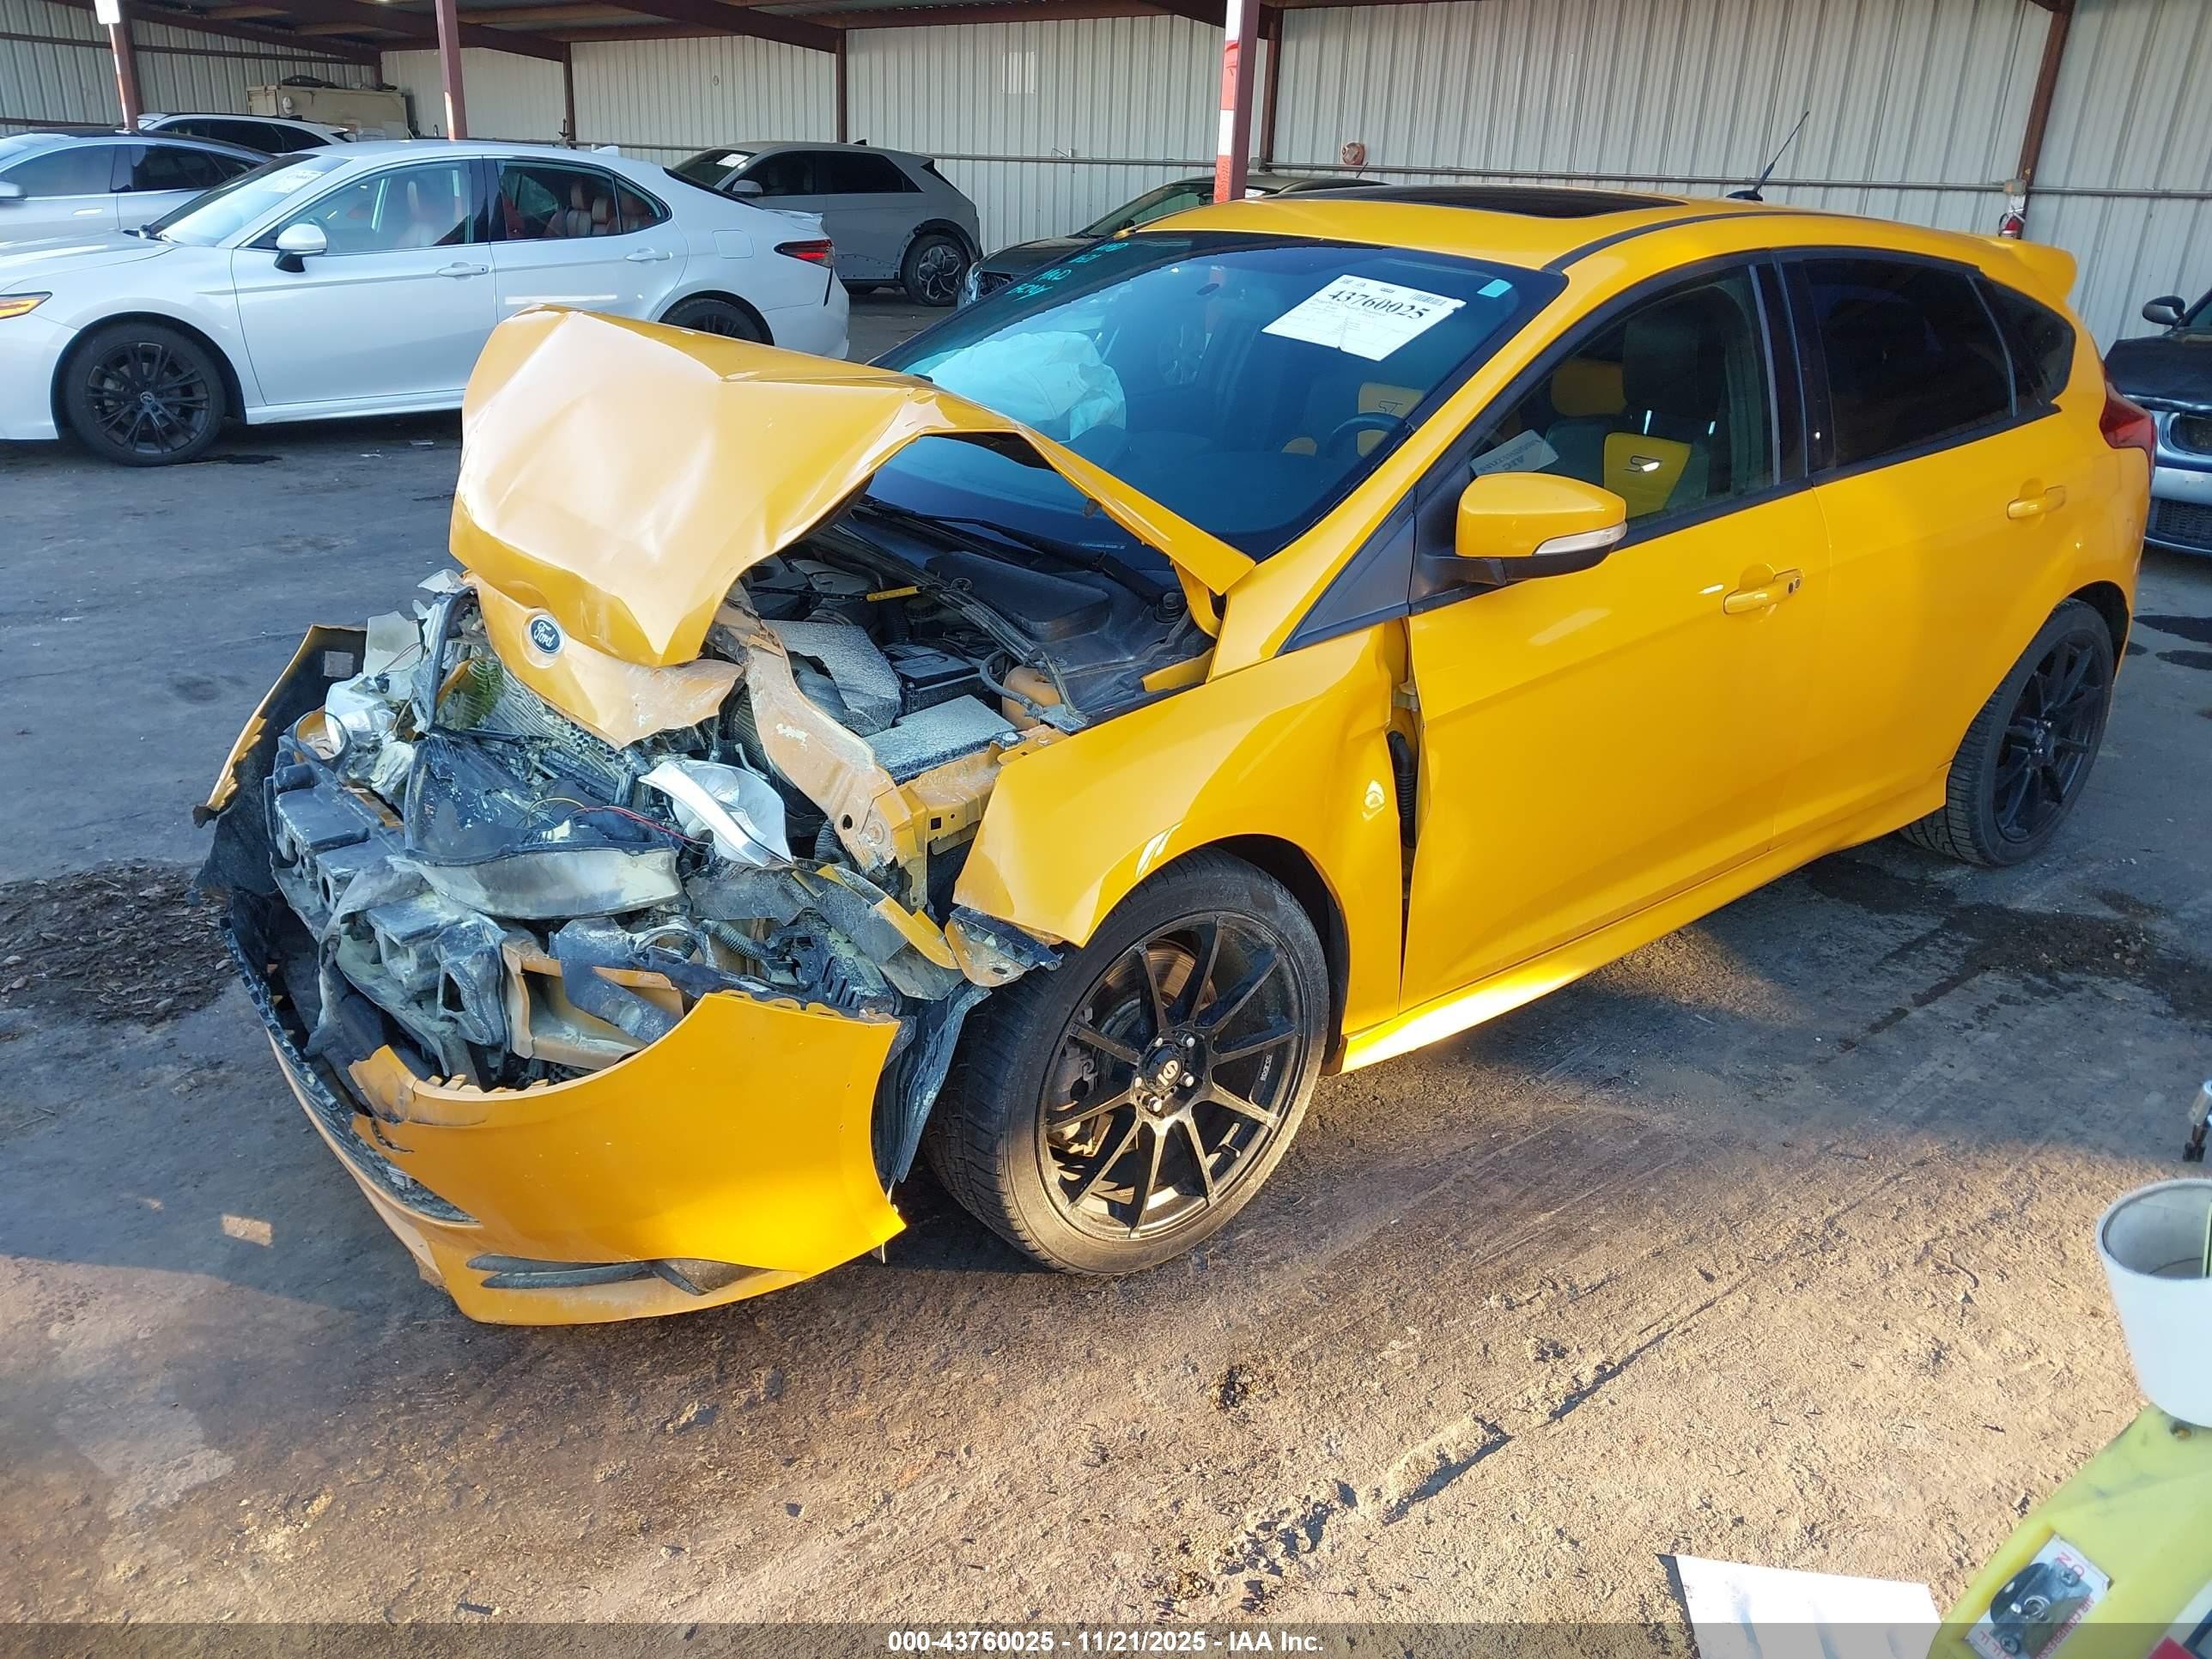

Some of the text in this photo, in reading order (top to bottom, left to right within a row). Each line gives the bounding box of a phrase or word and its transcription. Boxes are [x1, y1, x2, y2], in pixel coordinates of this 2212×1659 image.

[1328, 290, 1432, 320] 43760025
[533, 622, 556, 648] Ford
[2055, 1552, 2085, 1577] ON
[2078, 1595, 2095, 1615] AIR
